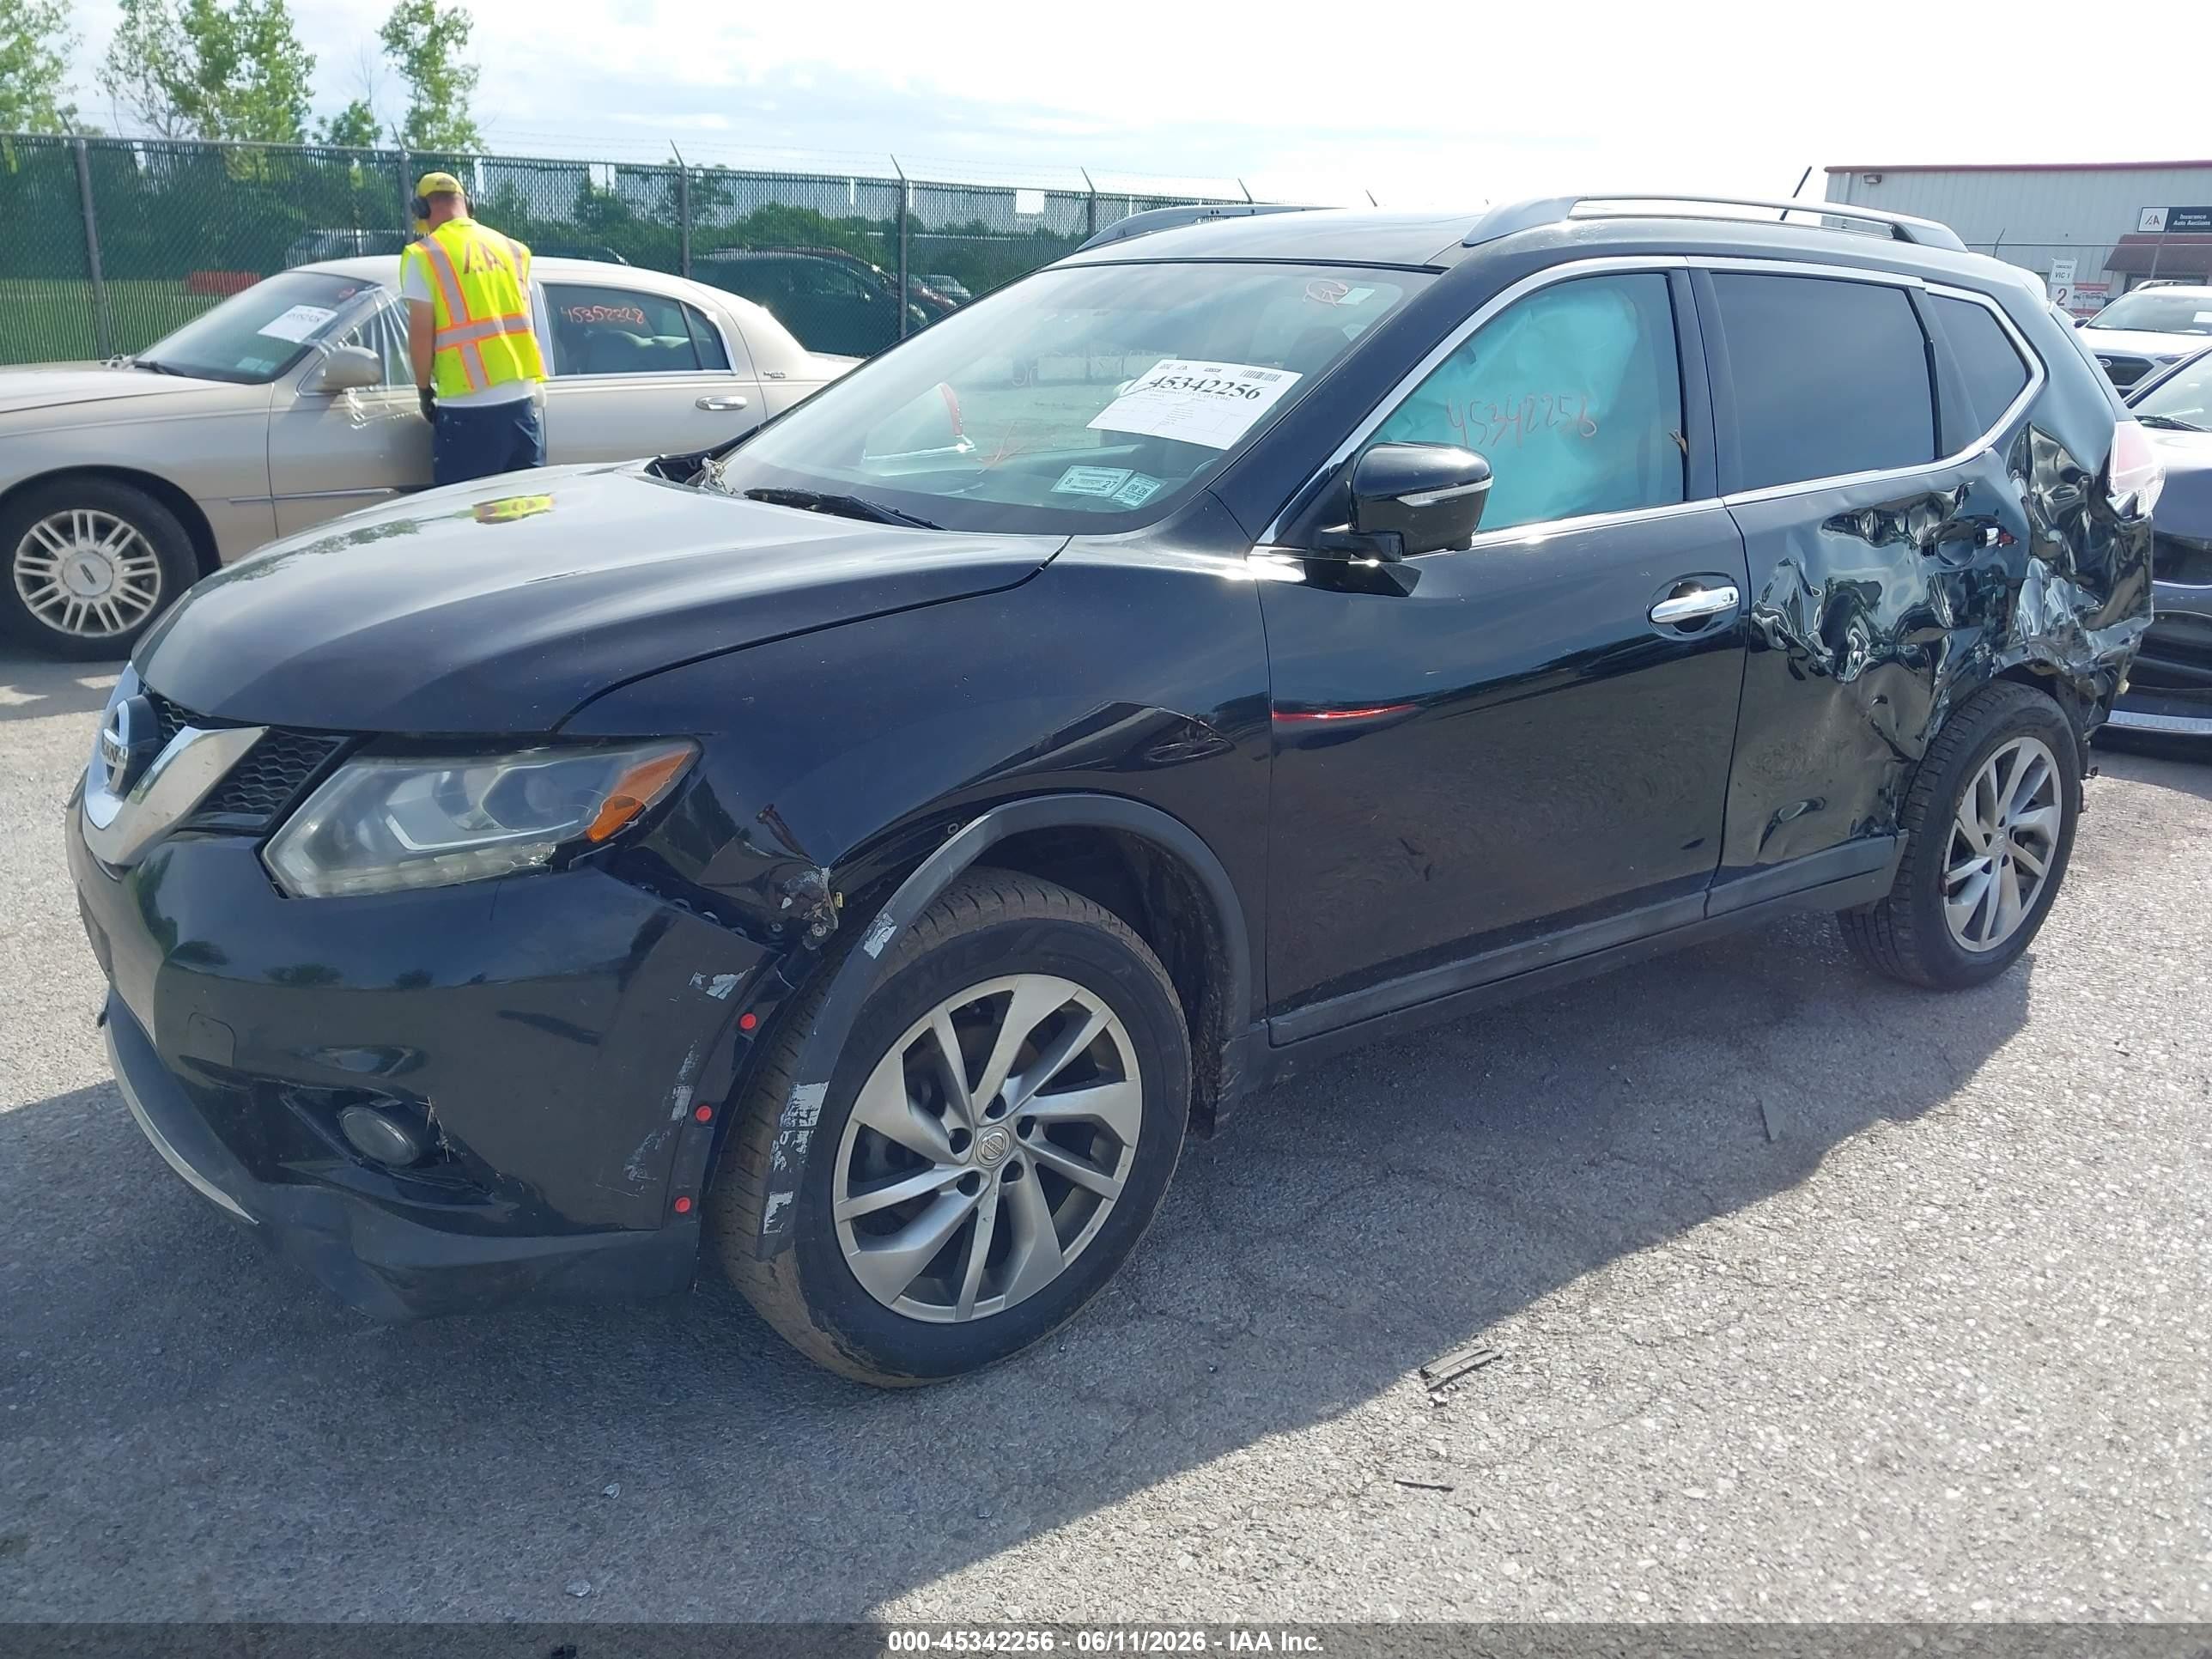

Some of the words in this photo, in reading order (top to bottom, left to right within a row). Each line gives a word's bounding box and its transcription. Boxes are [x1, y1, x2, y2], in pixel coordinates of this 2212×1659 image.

[2056, 288, 2068, 307] 2
[1149, 374, 1267, 401] 45342256
[1102, 480, 1118, 489] 27
